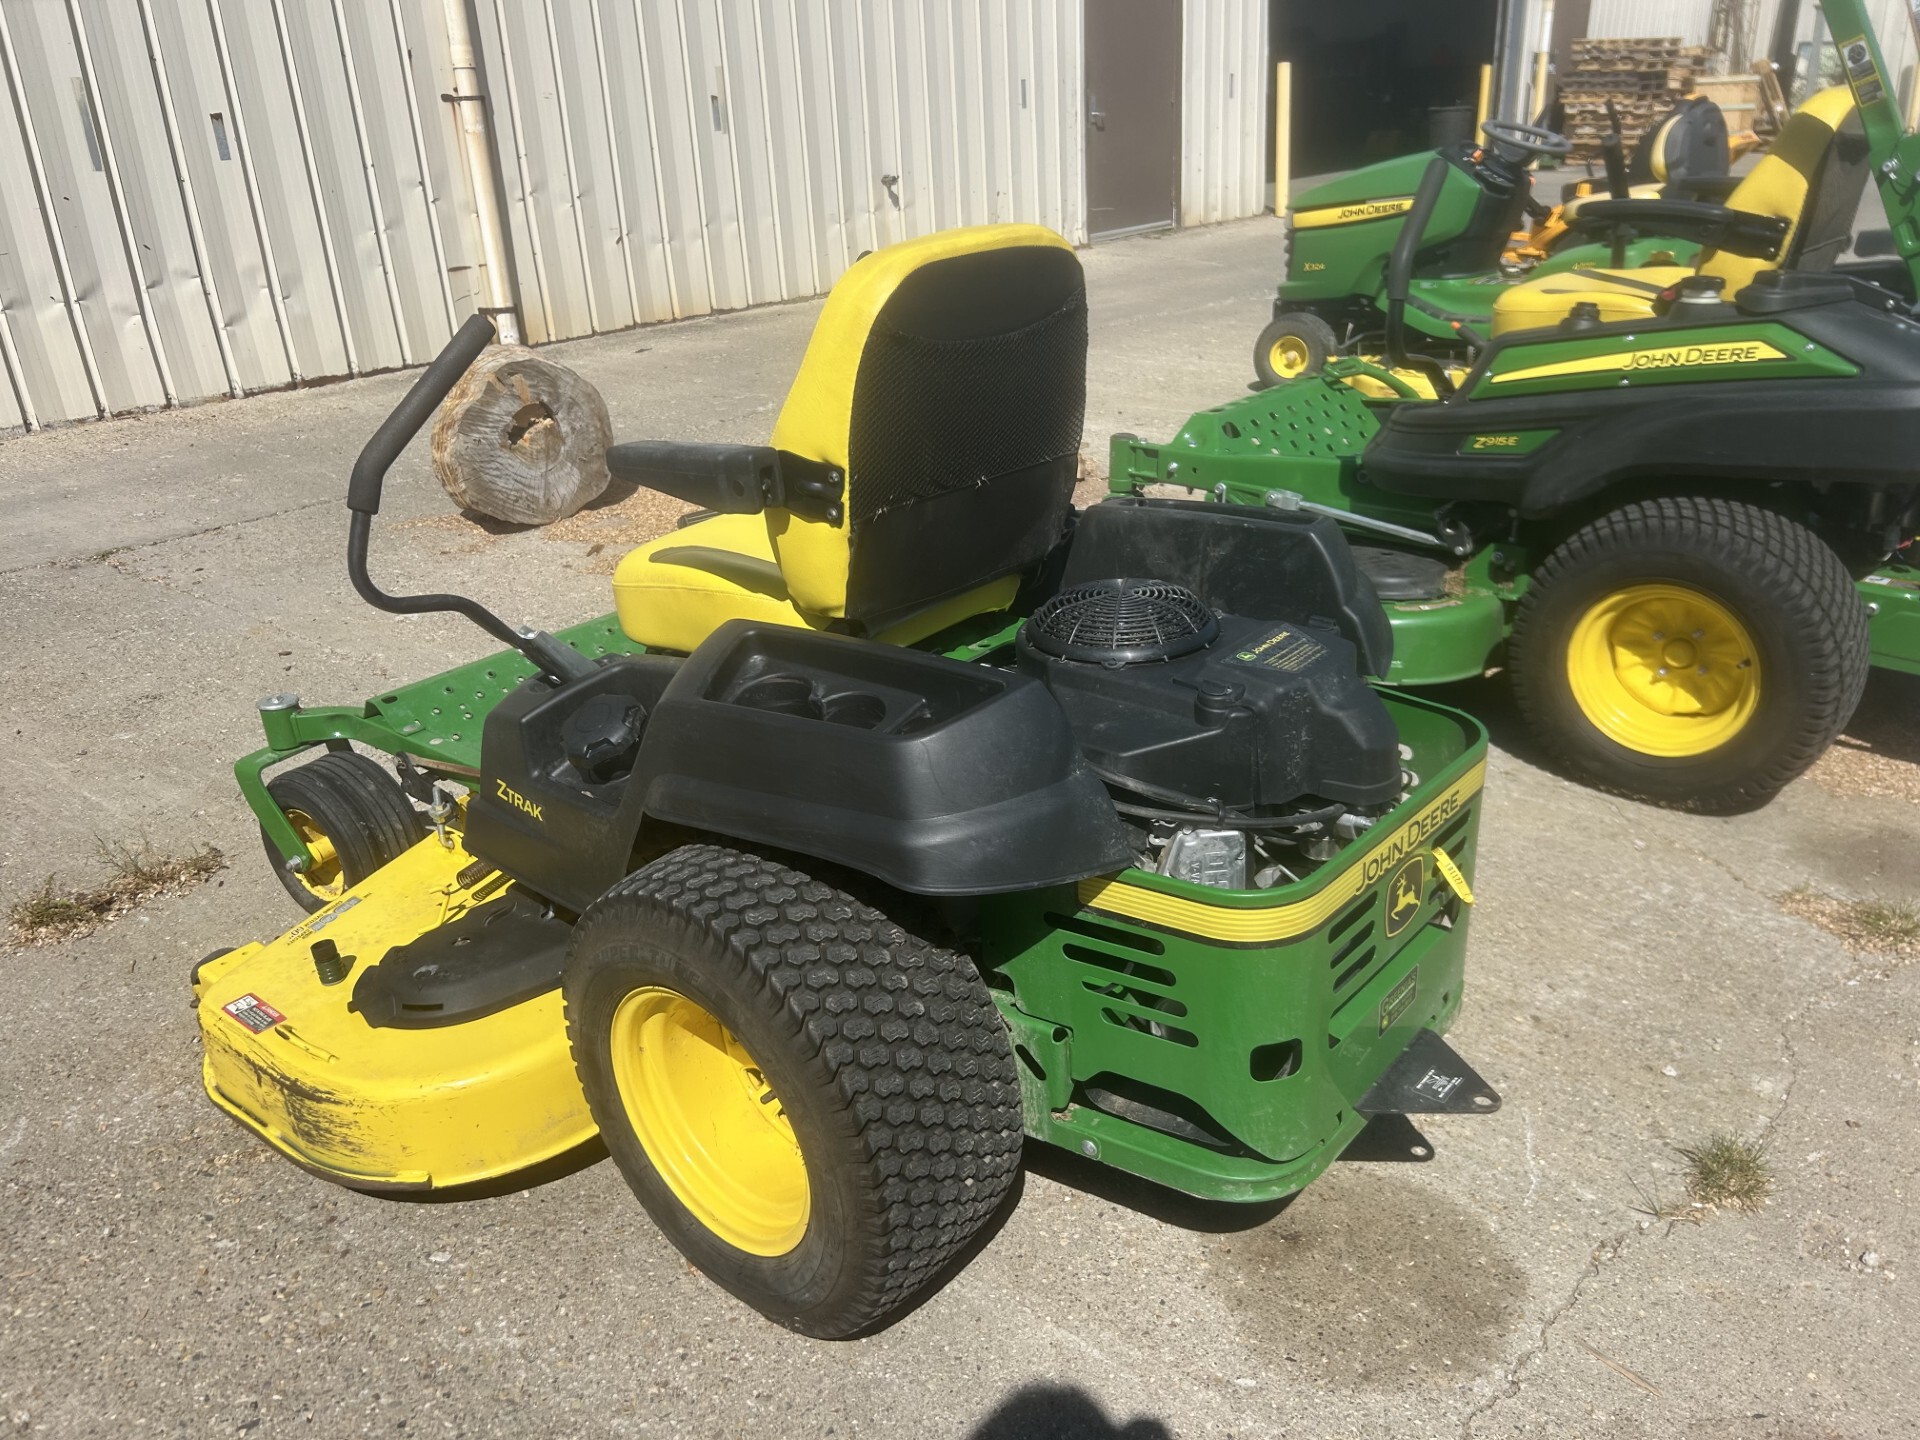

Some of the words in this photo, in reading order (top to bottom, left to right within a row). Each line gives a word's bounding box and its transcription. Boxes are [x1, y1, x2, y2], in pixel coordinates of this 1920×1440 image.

[1337, 207, 1365, 219] JOHN
[1366, 202, 1404, 215] DEERE
[1622, 351, 1681, 370] JOHN
[1685, 346, 1759, 363] DEERE
[1472, 435, 1520, 449] Z915E
[496, 778, 543, 822] ZTRAK
[1355, 835, 1405, 893] JOHN
[1407, 789, 1460, 848] DEERE
